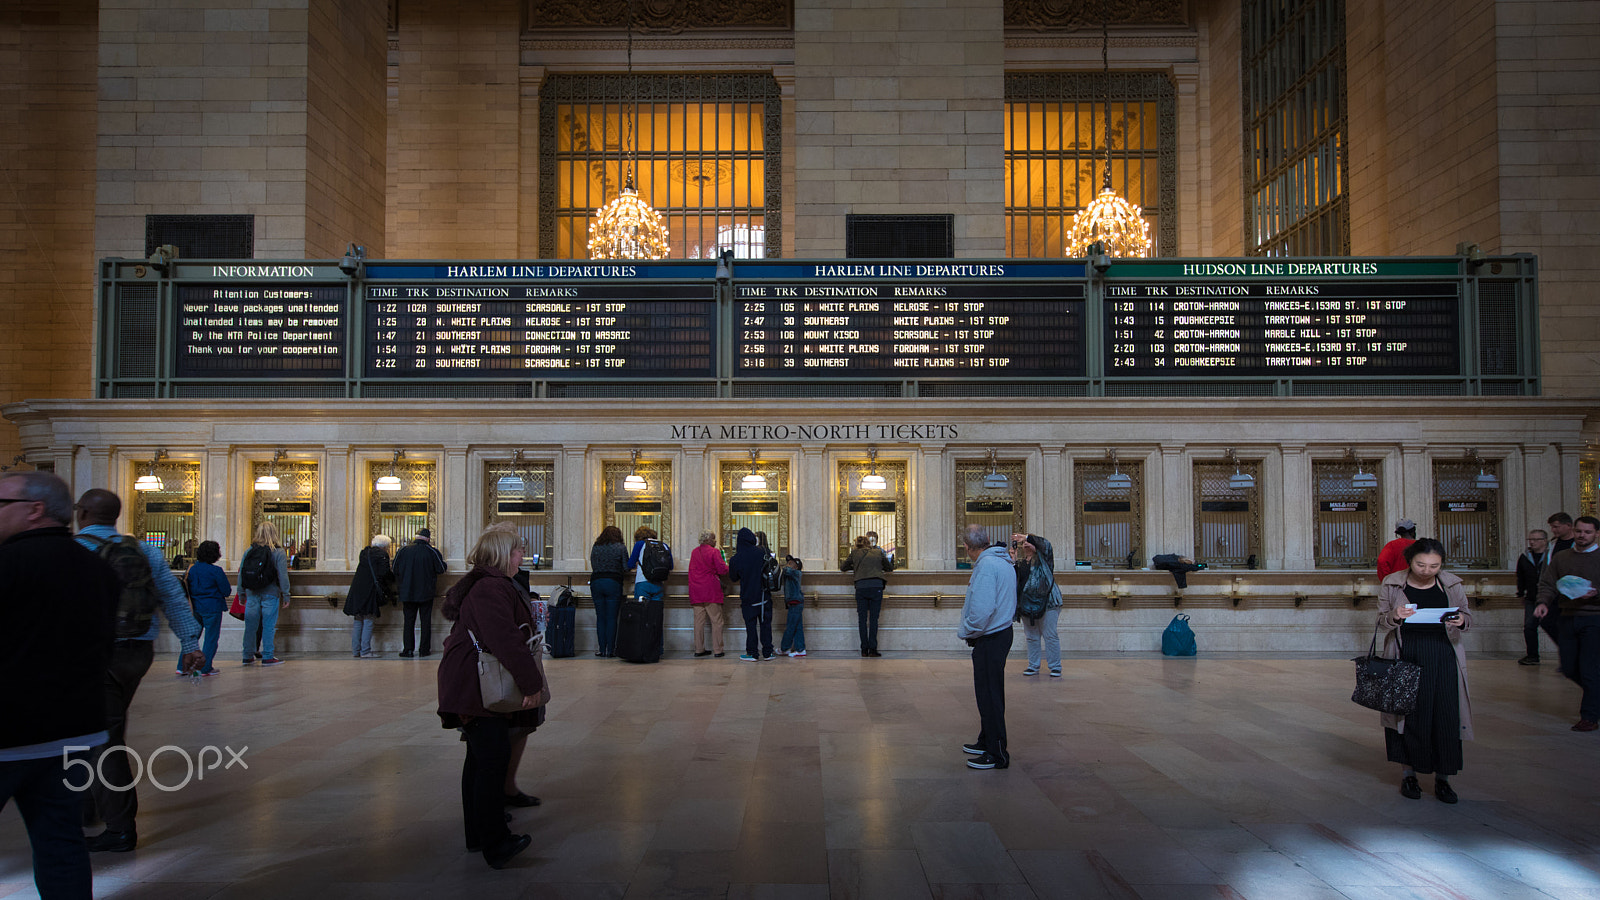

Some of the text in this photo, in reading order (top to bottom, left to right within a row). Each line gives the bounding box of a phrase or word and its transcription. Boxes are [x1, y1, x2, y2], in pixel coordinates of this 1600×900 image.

[213, 266, 314, 277] INFORMATION
[448, 266, 636, 277] HARLEM LINE DEPARTURES
[815, 265, 1004, 276] HARLEM LINE DEPARTURES
[1184, 263, 1377, 275] HUDSON LINE DEPARTURES
[213, 290, 312, 298] Attention Customers:
[371, 288, 577, 297] TIME TRK DESTINATION REMARKS
[740, 287, 946, 296] TIME TRK DESTINATION REMARKS
[1112, 286, 1319, 295] TIME TRK DESTINATION REMARKS
[214, 304, 238, 312] leave
[243, 304, 283, 313] packages
[288, 304, 338, 312] unattended
[378, 303, 626, 312] 1:22 102A SOUTHEAST SCARSDALE 1ST STOP
[744, 302, 984, 311] 2:25 105 N. WHITE PLAINS MELROSE 1ST STOP
[1115, 302, 1134, 311] 1:20
[1150, 302, 1164, 311] 114
[1174, 302, 1239, 311] CROTON-HARMON
[1345, 301, 1359, 310] ST.
[1366, 301, 1381, 310] 1ST
[1385, 301, 1406, 309] STOP
[184, 318, 338, 327] Unattended items may be removed
[378, 317, 616, 326] 1:25 28 N. WHITE PLAINS MELROSE 1ST STOP
[744, 316, 1009, 325] 2:47 30 SOUTHEAST WHITE PLAINS 1ST STOP
[1115, 315, 1366, 325] 1:43 15 POUGHKEEPSIE TARRYTOWN 1ST STOP
[192, 331, 332, 341] By the MTA Police Department
[377, 331, 630, 340] 1:47 21 SOUTHEAST CONNECTION TO WASSAIC
[744, 330, 994, 339] 2:53 106 MOUNT KISCO SCARSDALE 1ST STOP
[1115, 329, 1377, 339] 1:51 42 CROTON-HARMON MARBLE HILL 1ST STOP
[188, 345, 212, 353] Thank
[238, 345, 253, 353] for
[283, 345, 338, 355] cooperation
[377, 344, 616, 354] 1:54 29 WHITE PLAINS FORDHAM 1ST STOP
[744, 344, 984, 353] 2:56 21 N. WHITE PLAINS FORDHAM 1ST STOP
[1114, 344, 1135, 353] 2:20
[1150, 344, 1165, 353] 103
[1174, 344, 1240, 353] CROTON-HARMON
[1346, 343, 1360, 351] ST.
[1367, 343, 1381, 351] 1ST
[1387, 343, 1407, 351] STOP
[376, 359, 625, 368] 2:22 20 SOUTHEAST SCARSDALE 1ST STOP
[744, 358, 1010, 367] 3:16 39 SOUTHEAST WHITE PLAINS 1ST STOP
[1114, 357, 1367, 367] 2:43 34 POUGHKEEPSIE TARRYTOWN 1ST STOP
[672, 425, 958, 439] MTA METRO-NORTH TICKETS
